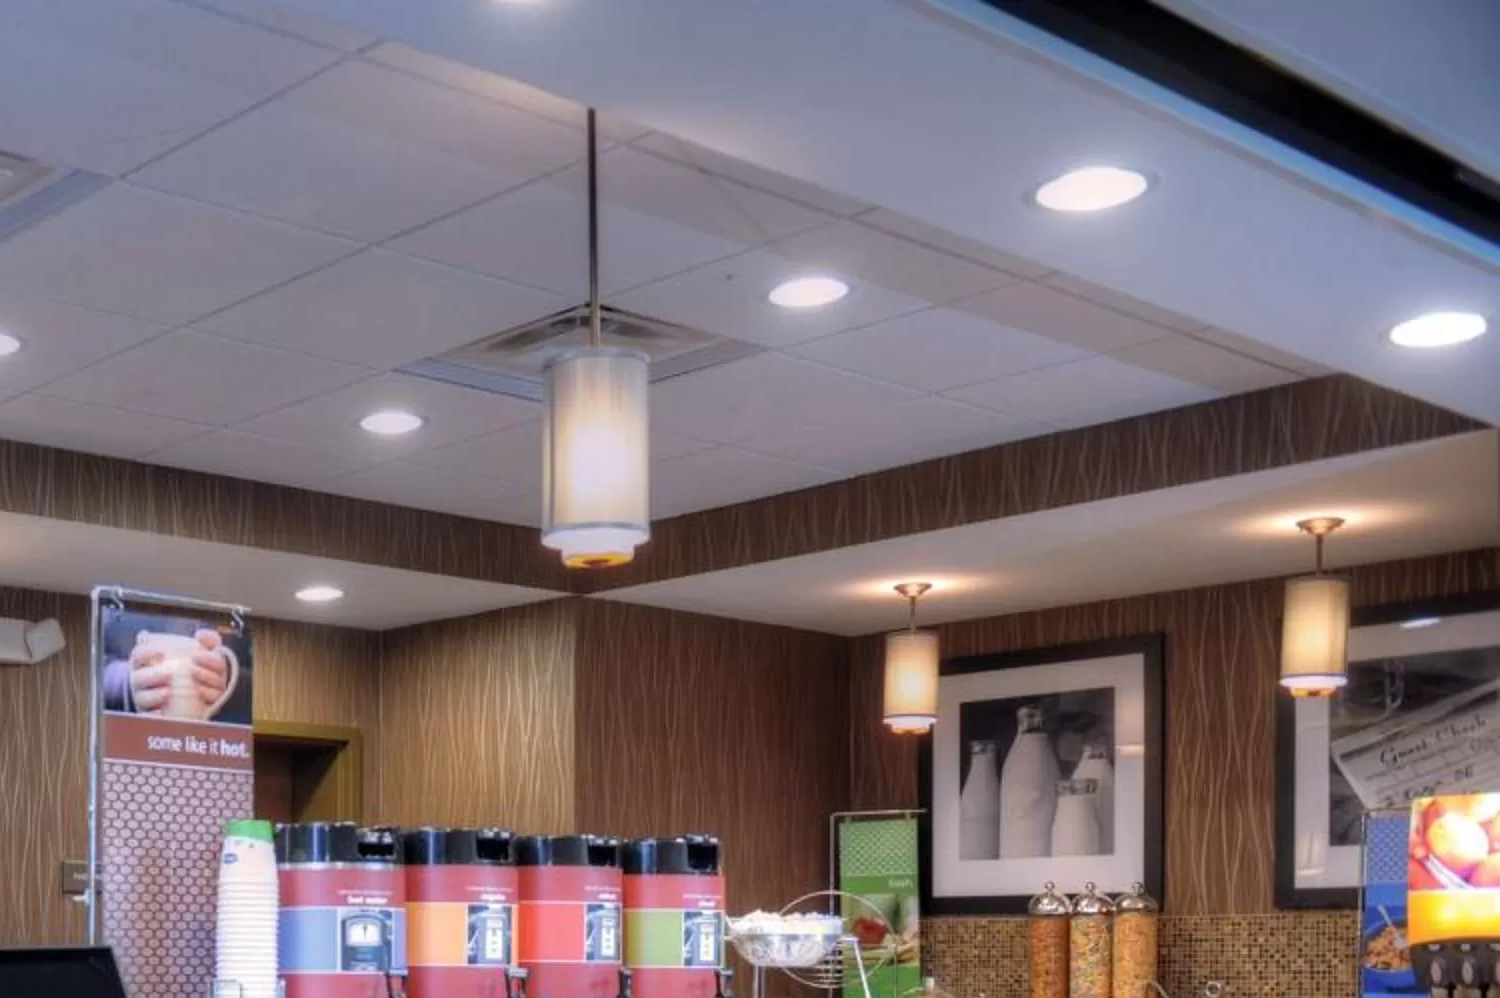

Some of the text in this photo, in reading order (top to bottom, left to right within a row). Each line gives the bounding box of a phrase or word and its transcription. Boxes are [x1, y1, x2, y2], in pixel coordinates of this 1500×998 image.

[148, 735, 182, 752] some
[184, 735, 208, 755] like
[209, 737, 219, 756] it
